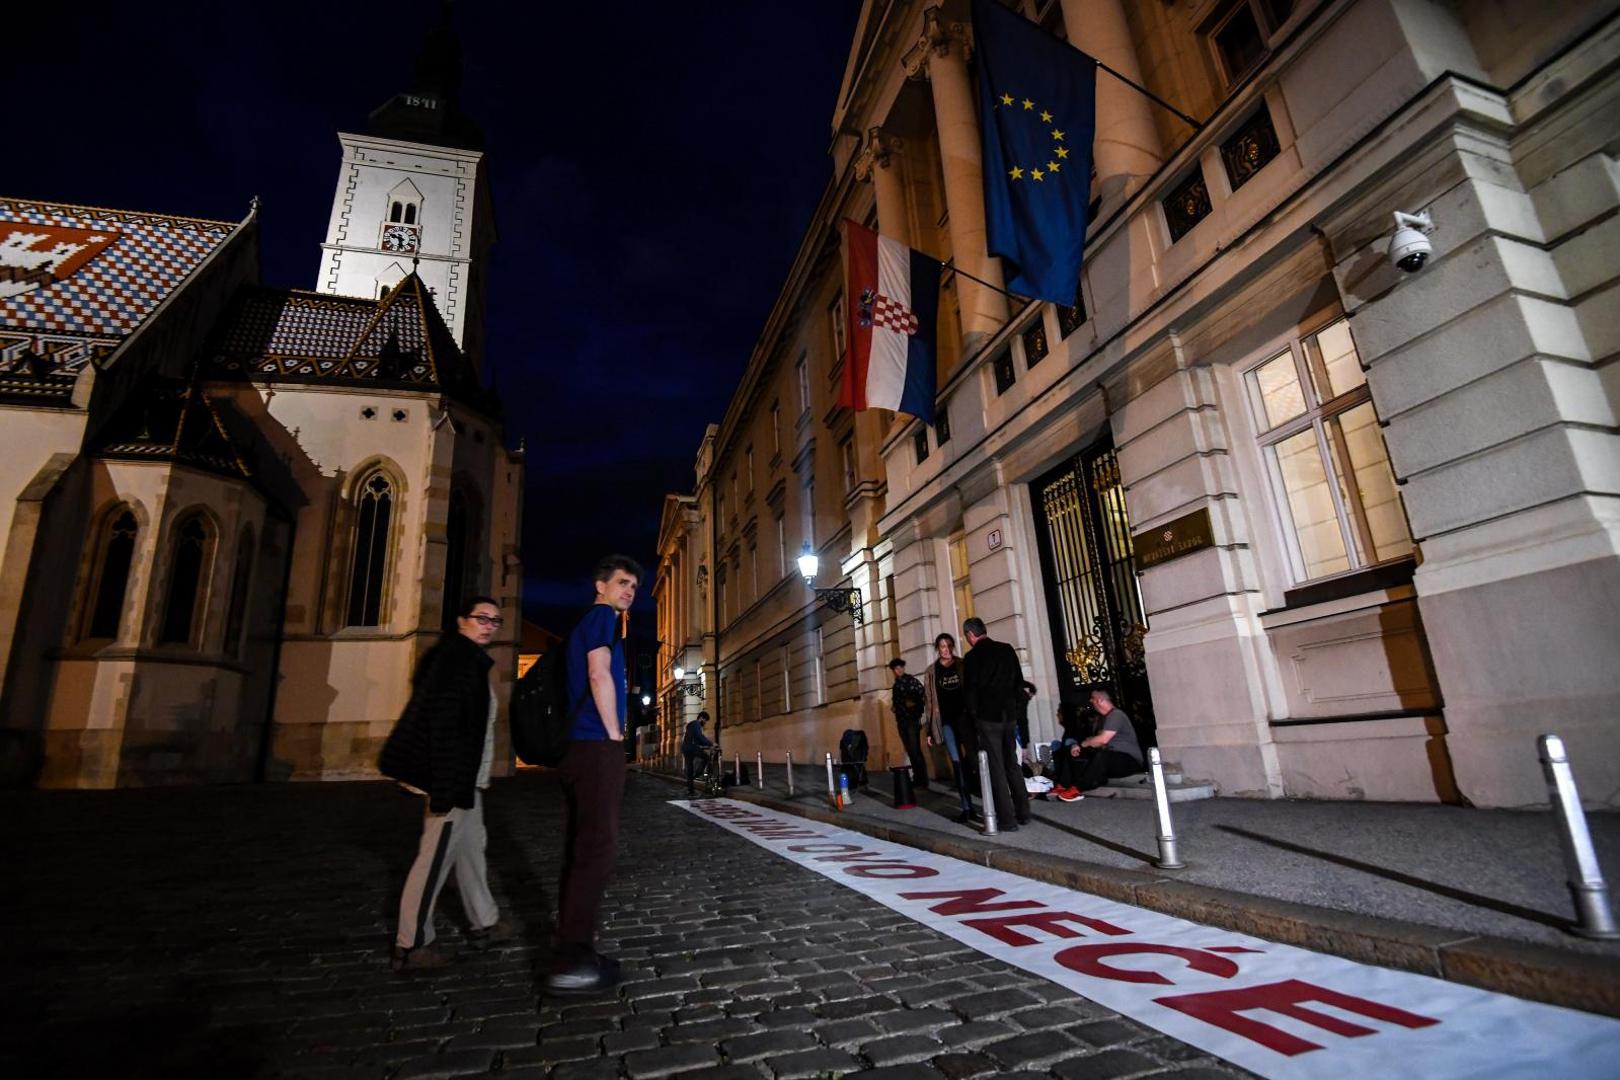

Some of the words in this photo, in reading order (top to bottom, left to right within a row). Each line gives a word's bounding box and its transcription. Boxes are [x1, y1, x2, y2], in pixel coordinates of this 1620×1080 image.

[730, 819, 828, 840] VAM
[787, 843, 940, 879] OVO
[898, 887, 1442, 1056] NEĆE
